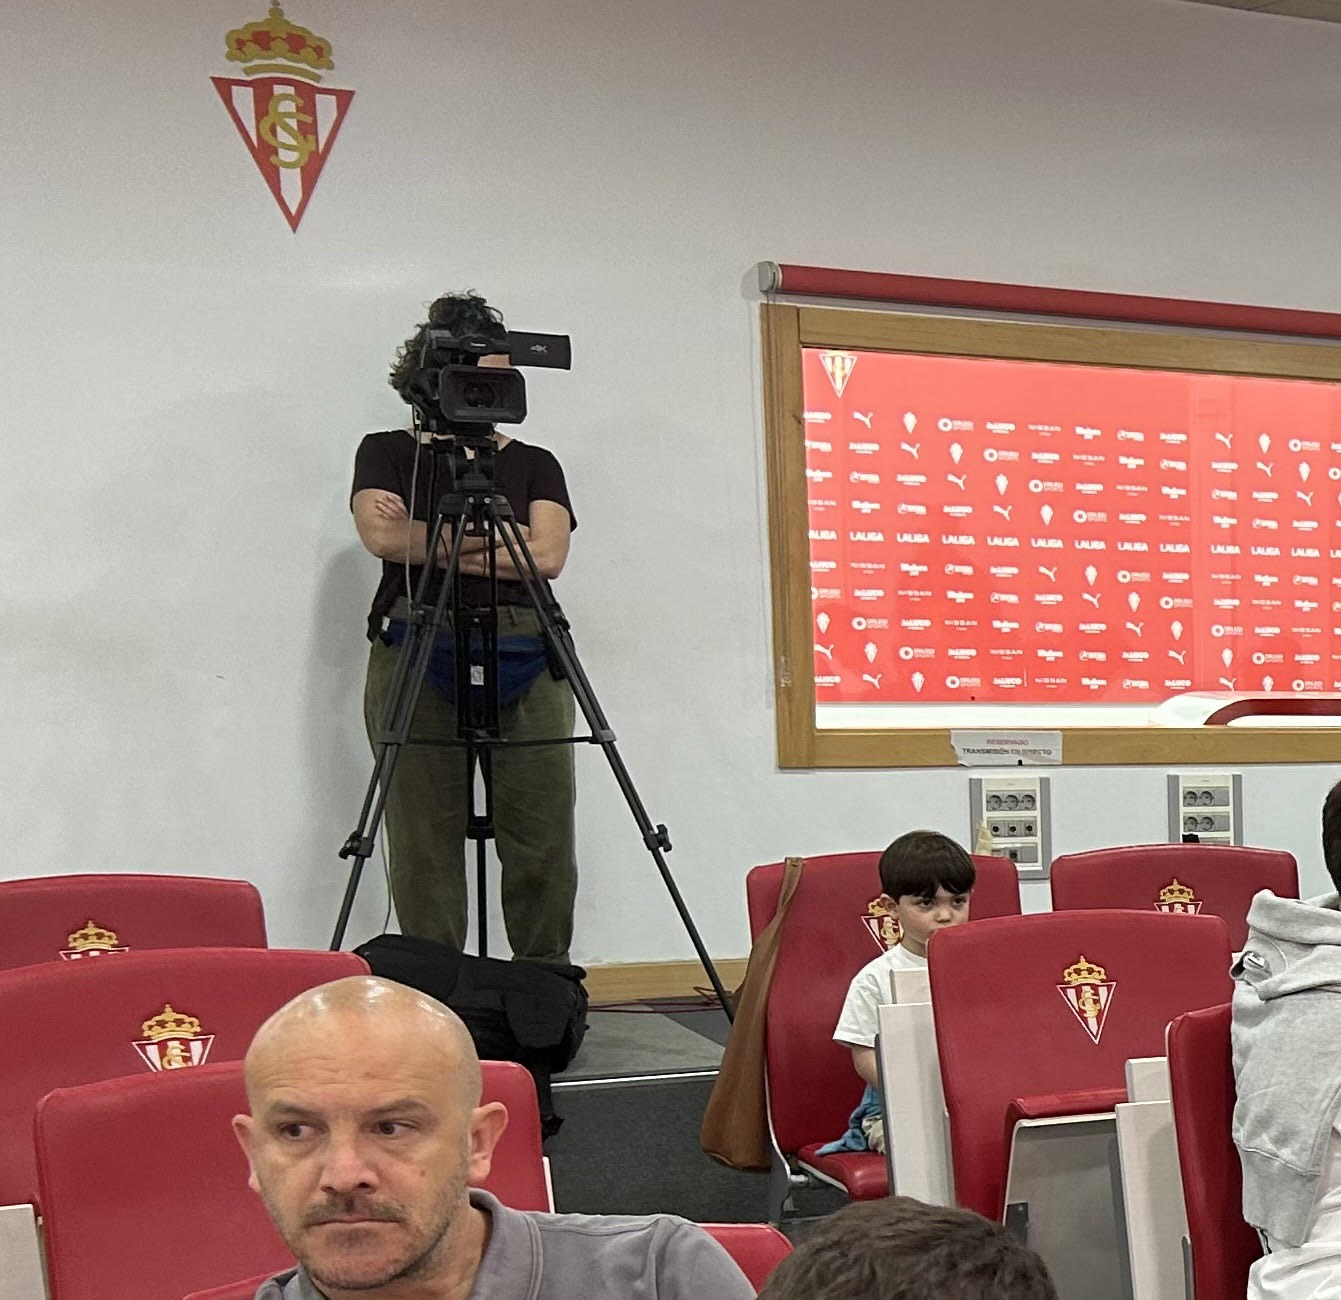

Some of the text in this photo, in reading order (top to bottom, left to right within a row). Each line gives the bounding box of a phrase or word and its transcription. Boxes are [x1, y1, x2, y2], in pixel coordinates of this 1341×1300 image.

[849, 531, 884, 542] LALIGA
[896, 533, 930, 543] LALIGA
[941, 534, 975, 545] LALIGA
[987, 536, 1020, 547] LALIGA
[1031, 538, 1063, 548] LALIGA
[1074, 540, 1106, 550] LALIGA
[1117, 541, 1149, 552] LALIGA
[1159, 544, 1190, 553] LALIGA
